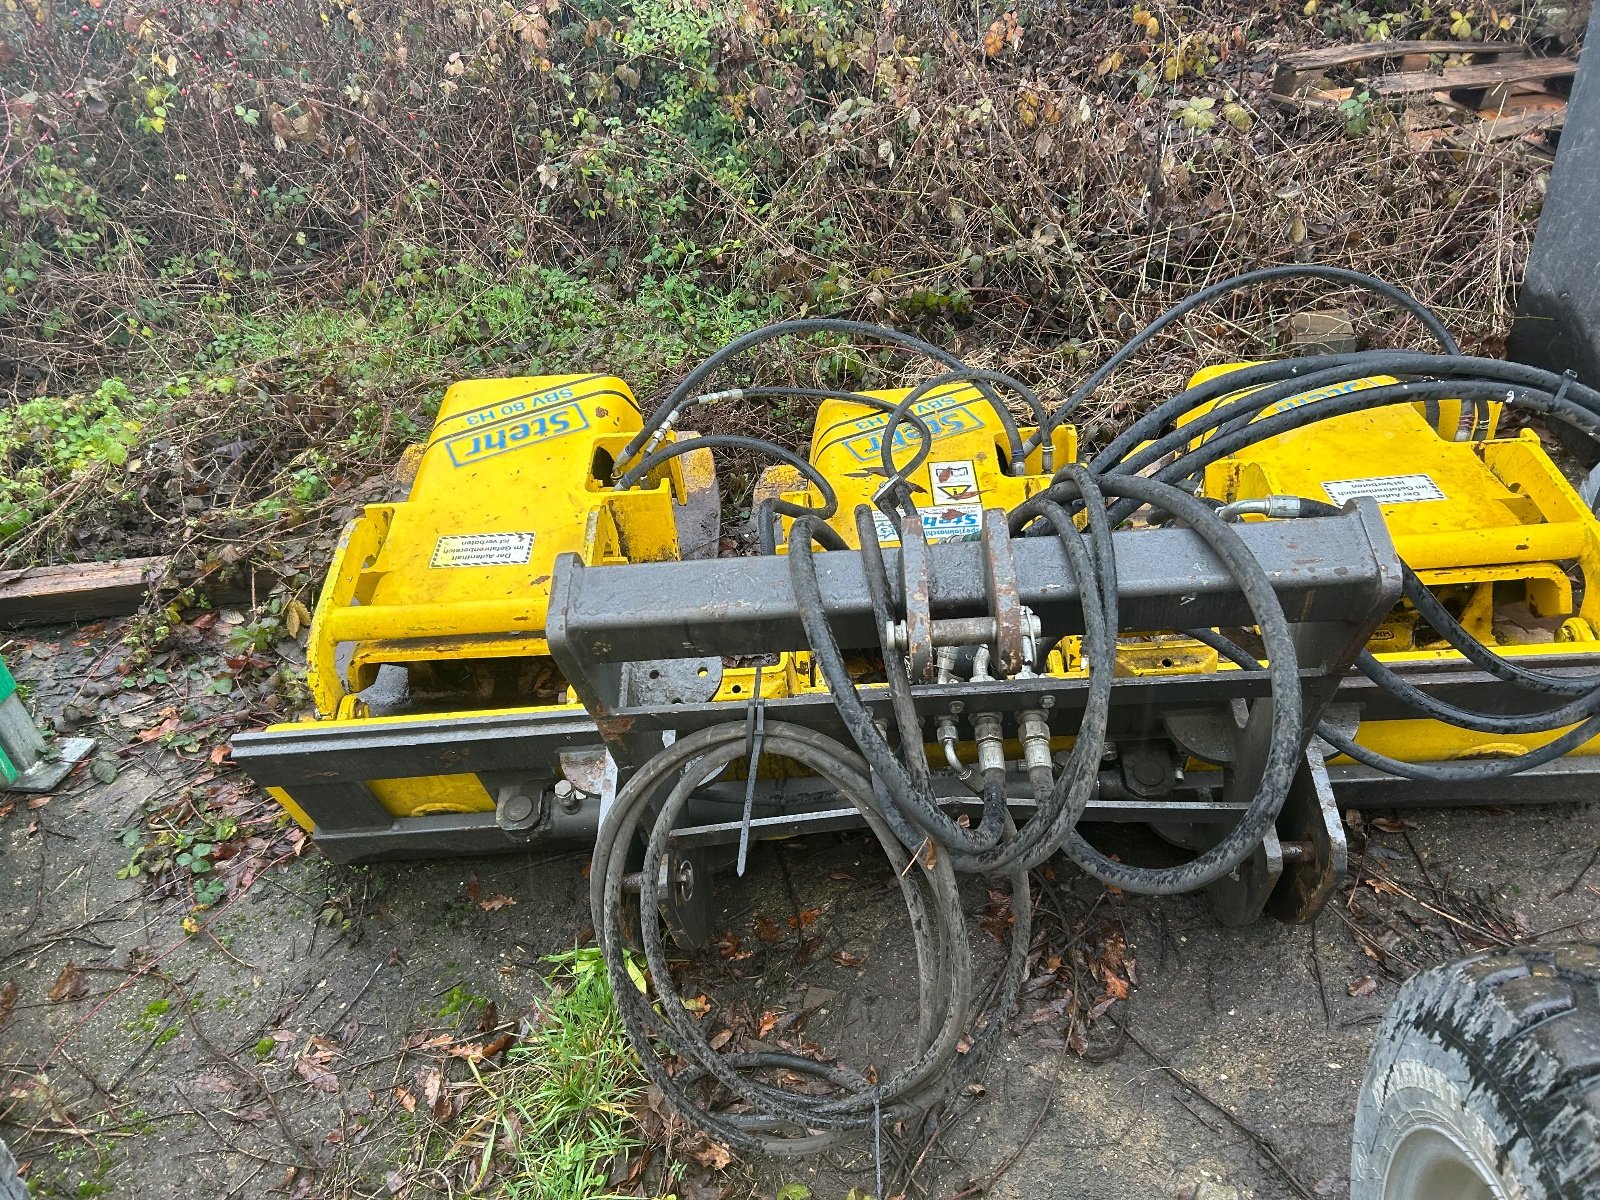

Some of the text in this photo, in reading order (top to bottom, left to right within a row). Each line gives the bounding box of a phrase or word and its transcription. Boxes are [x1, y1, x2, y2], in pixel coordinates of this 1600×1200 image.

[467, 388, 574, 426] SBV 80 H3
[917, 397, 956, 414] SBV
[855, 411, 882, 431] H3
[465, 410, 570, 457] Stehr
[1337, 486, 1414, 497] Gefahrenbereich
[1351, 481, 1393, 489] verboten
[922, 513, 978, 528] Steh
[443, 545, 512, 555] Gefahrenbereich
[451, 553, 495, 561] Aufenthalt
